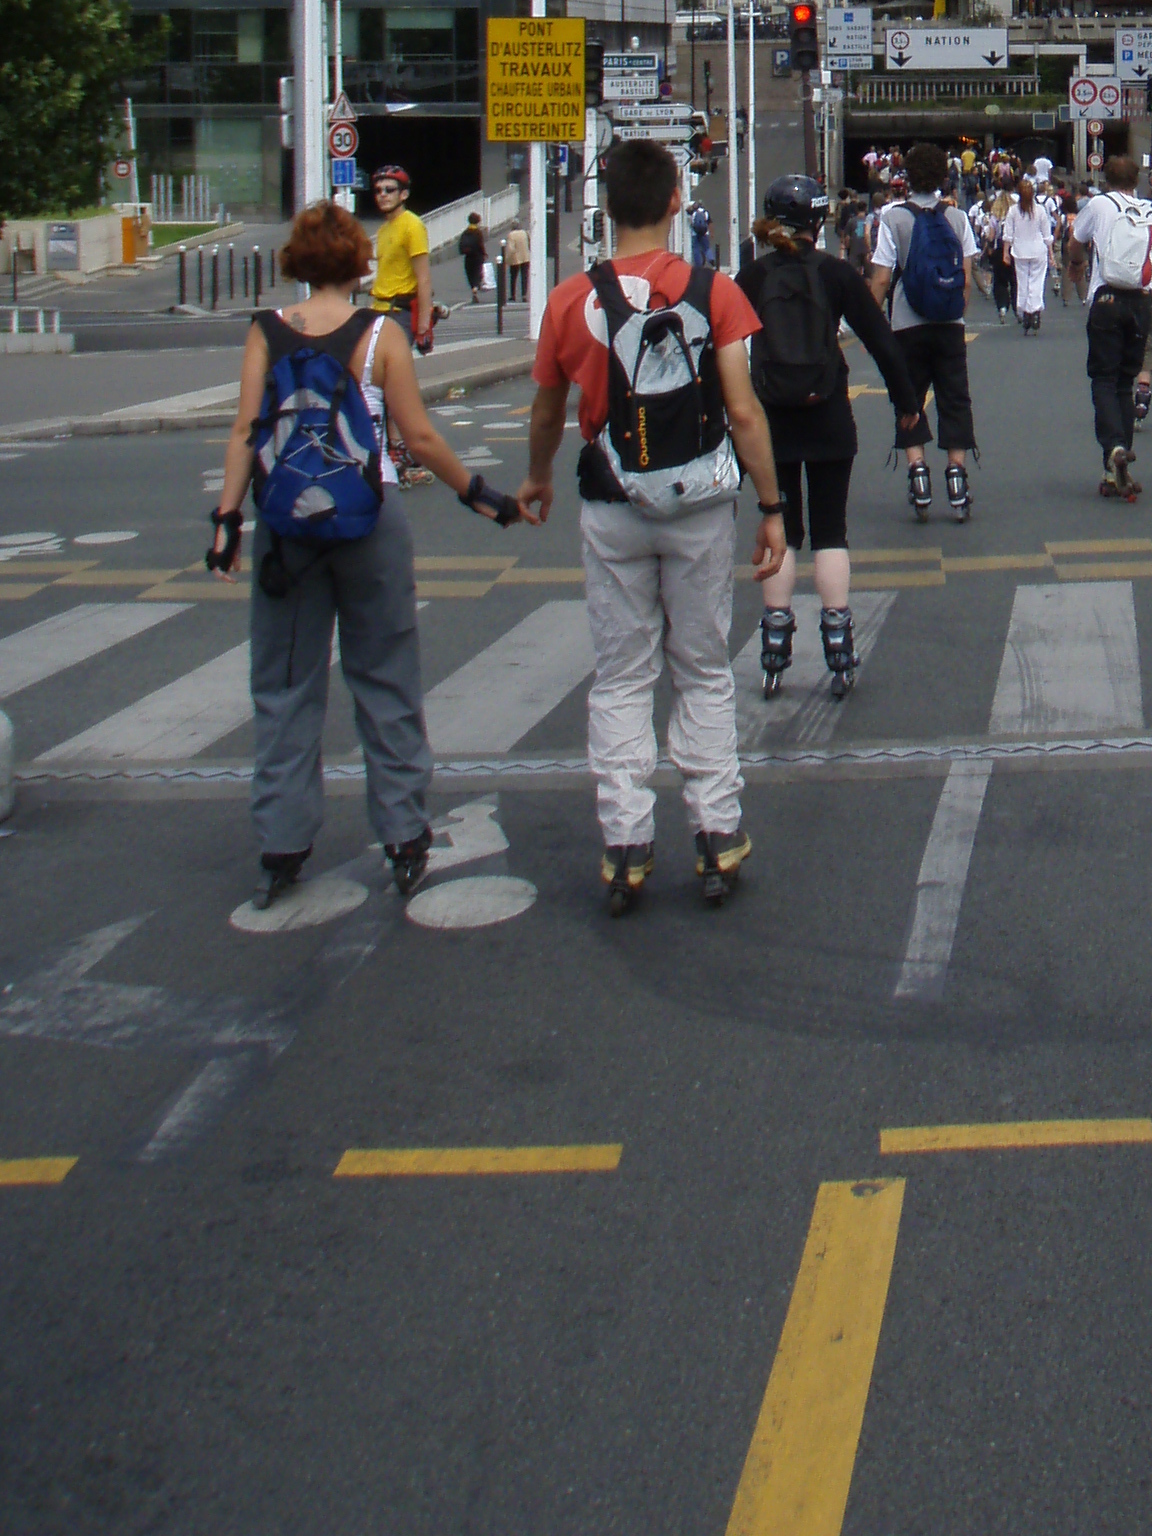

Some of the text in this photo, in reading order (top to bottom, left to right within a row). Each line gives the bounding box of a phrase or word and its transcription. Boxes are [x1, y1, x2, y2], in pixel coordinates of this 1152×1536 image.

[519, 22, 554, 37] PONT
[924, 36, 971, 46] NATION
[491, 42, 582, 57] D'AUSTERLITZ
[500, 62, 572, 77] TRAVAUX
[490, 82, 582, 97] CHAUFFAGE URBAIN
[492, 102, 580, 117] CIRCULATION
[495, 122, 577, 138] RESTREINTE
[334, 132, 351, 147] 30
[638, 406, 650, 467] Quechua
